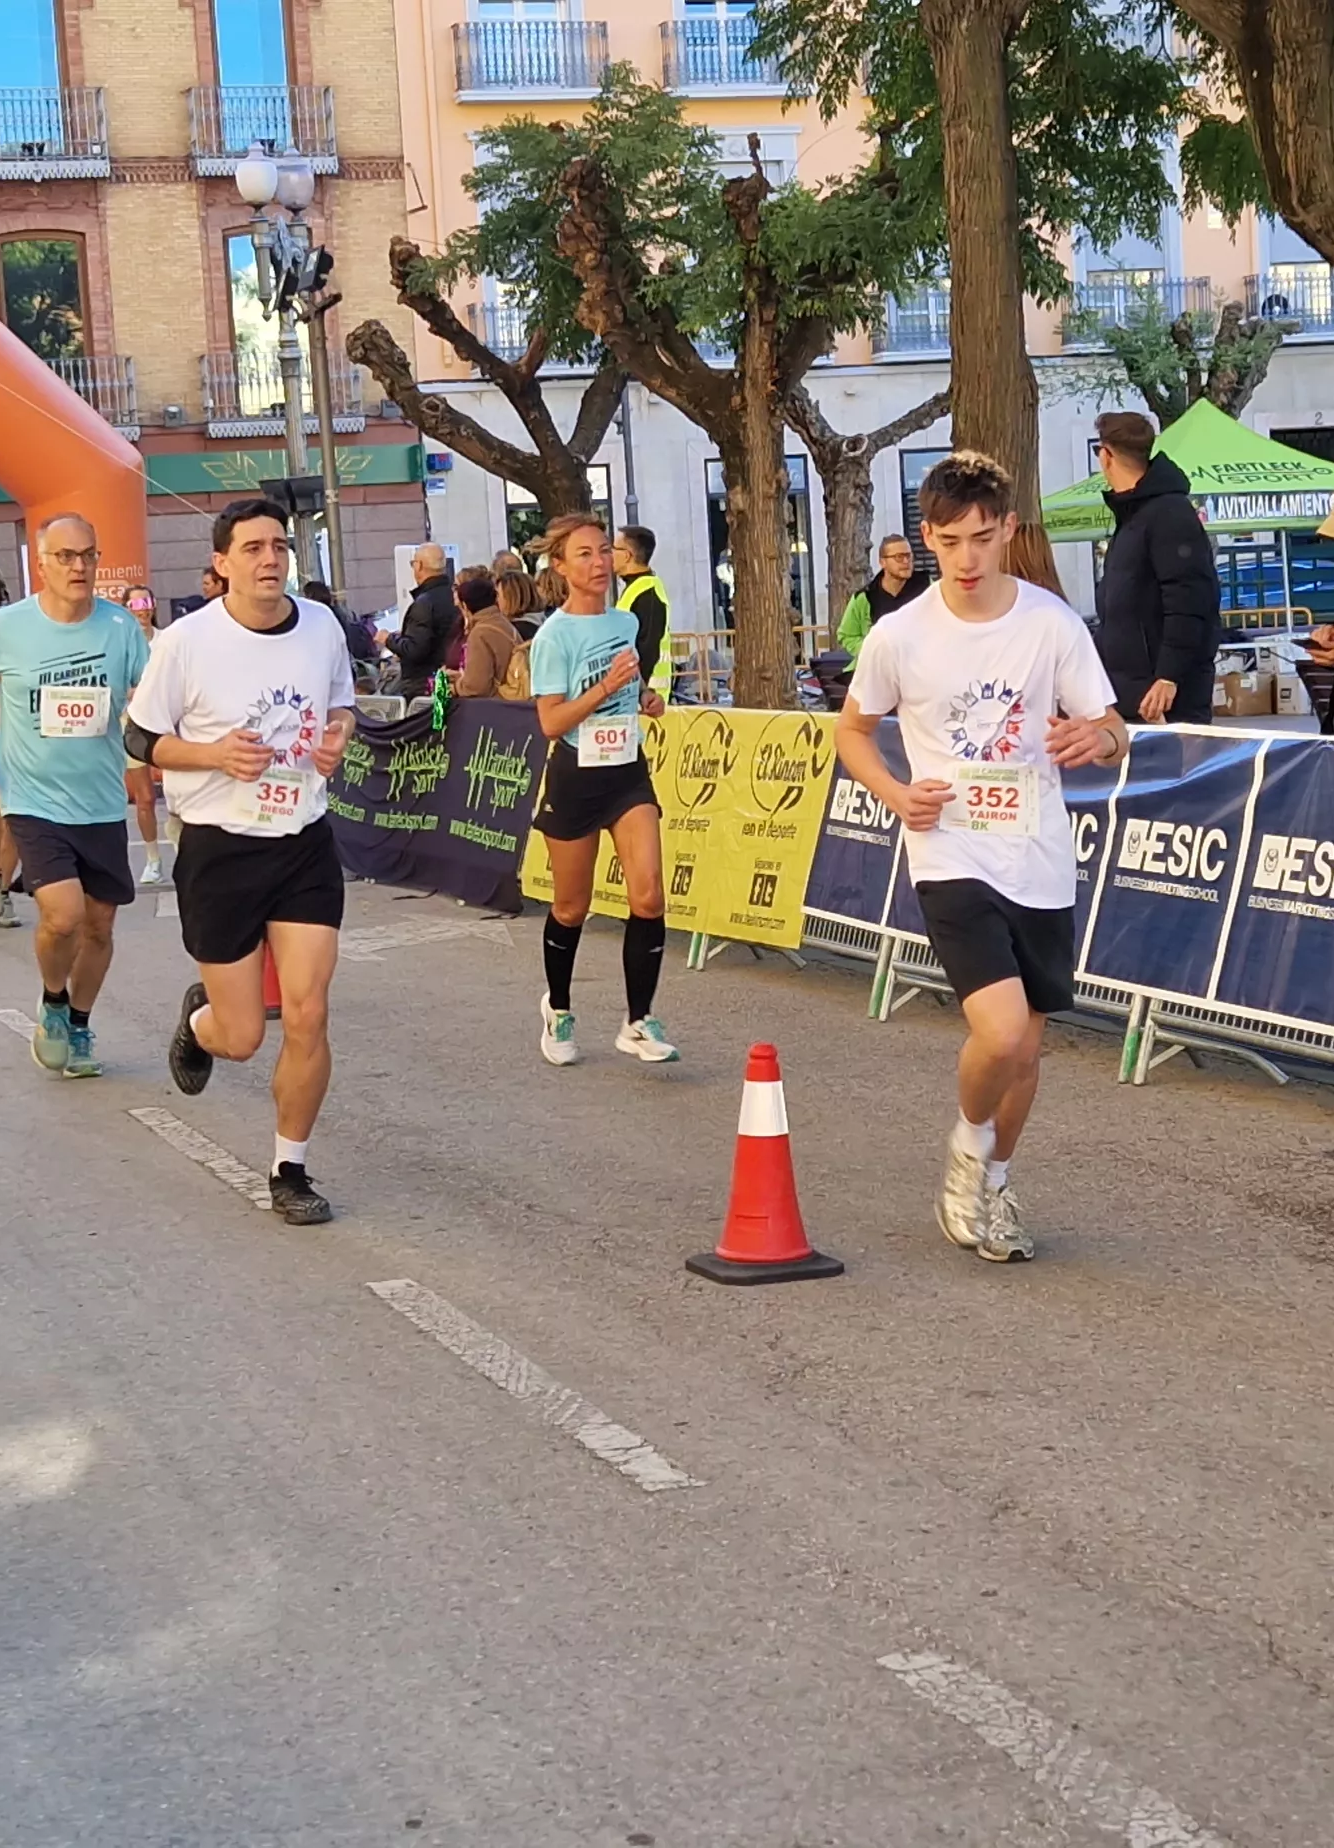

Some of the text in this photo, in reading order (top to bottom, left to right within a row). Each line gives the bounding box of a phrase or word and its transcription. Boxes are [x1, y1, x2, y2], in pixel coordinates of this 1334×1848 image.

[1314, 411, 1324, 425] 2
[1212, 460, 1308, 474] FARTLECK
[1224, 473, 1316, 485] SPORT
[95, 564, 144, 580] miento
[53, 664, 93, 682] CARRERA
[57, 703, 94, 718] 600
[594, 728, 627, 745] 601
[256, 782, 301, 806] 351
[967, 785, 1019, 808] 352
[260, 803, 295, 817] DIEGO
[969, 809, 1017, 821] YAIRON
[971, 820, 989, 831] 8K
[1070, 811, 1089, 863] IC
[1143, 820, 1228, 881] ESIC
